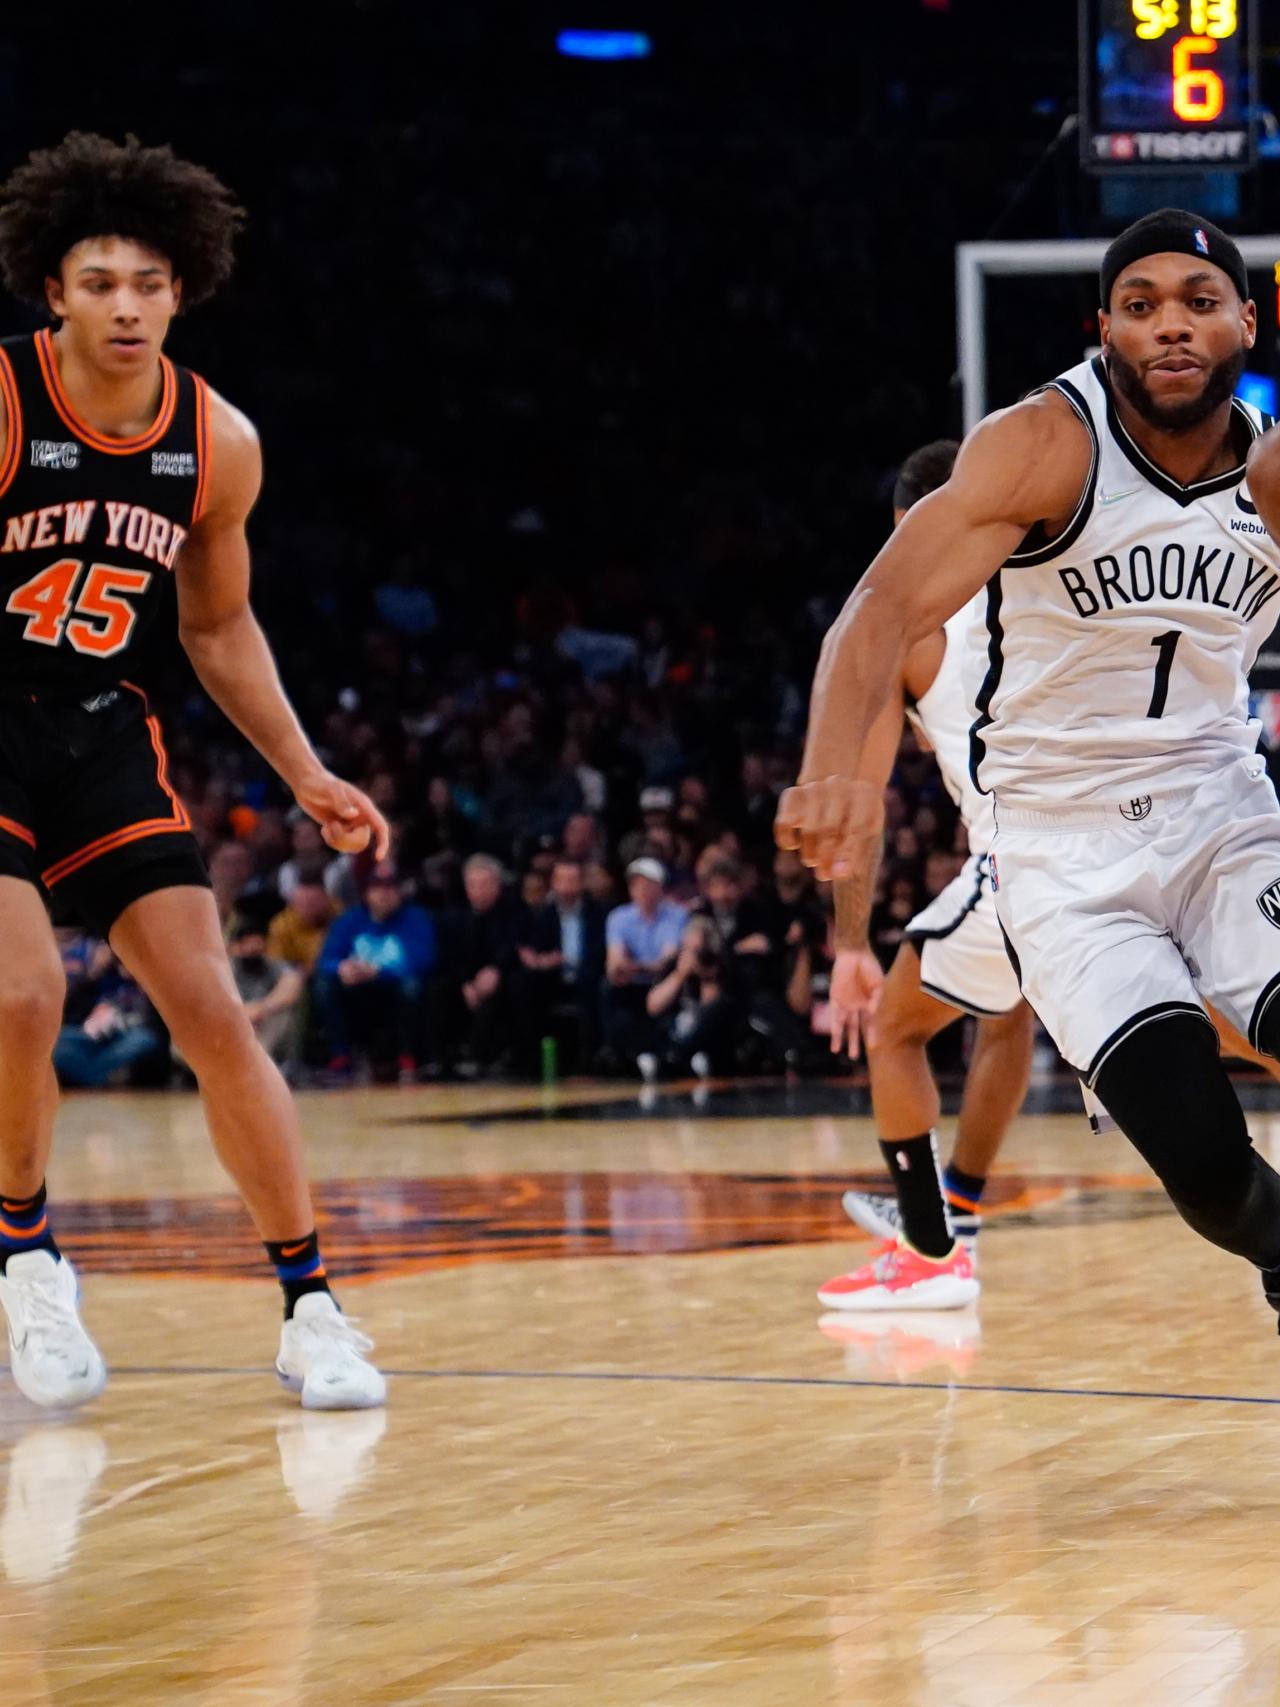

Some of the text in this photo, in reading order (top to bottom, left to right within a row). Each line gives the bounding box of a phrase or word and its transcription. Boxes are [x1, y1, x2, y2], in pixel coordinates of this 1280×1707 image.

[1131, 0, 1237, 39] 5:13
[1172, 36, 1223, 121] 6
[1134, 131, 1247, 160] TISSOT
[151, 452, 193, 464] SQUARE
[151, 464, 185, 476] SPACE
[0, 500, 96, 553] NEW
[5, 558, 153, 659] 45
[1146, 630, 1182, 718] 1
